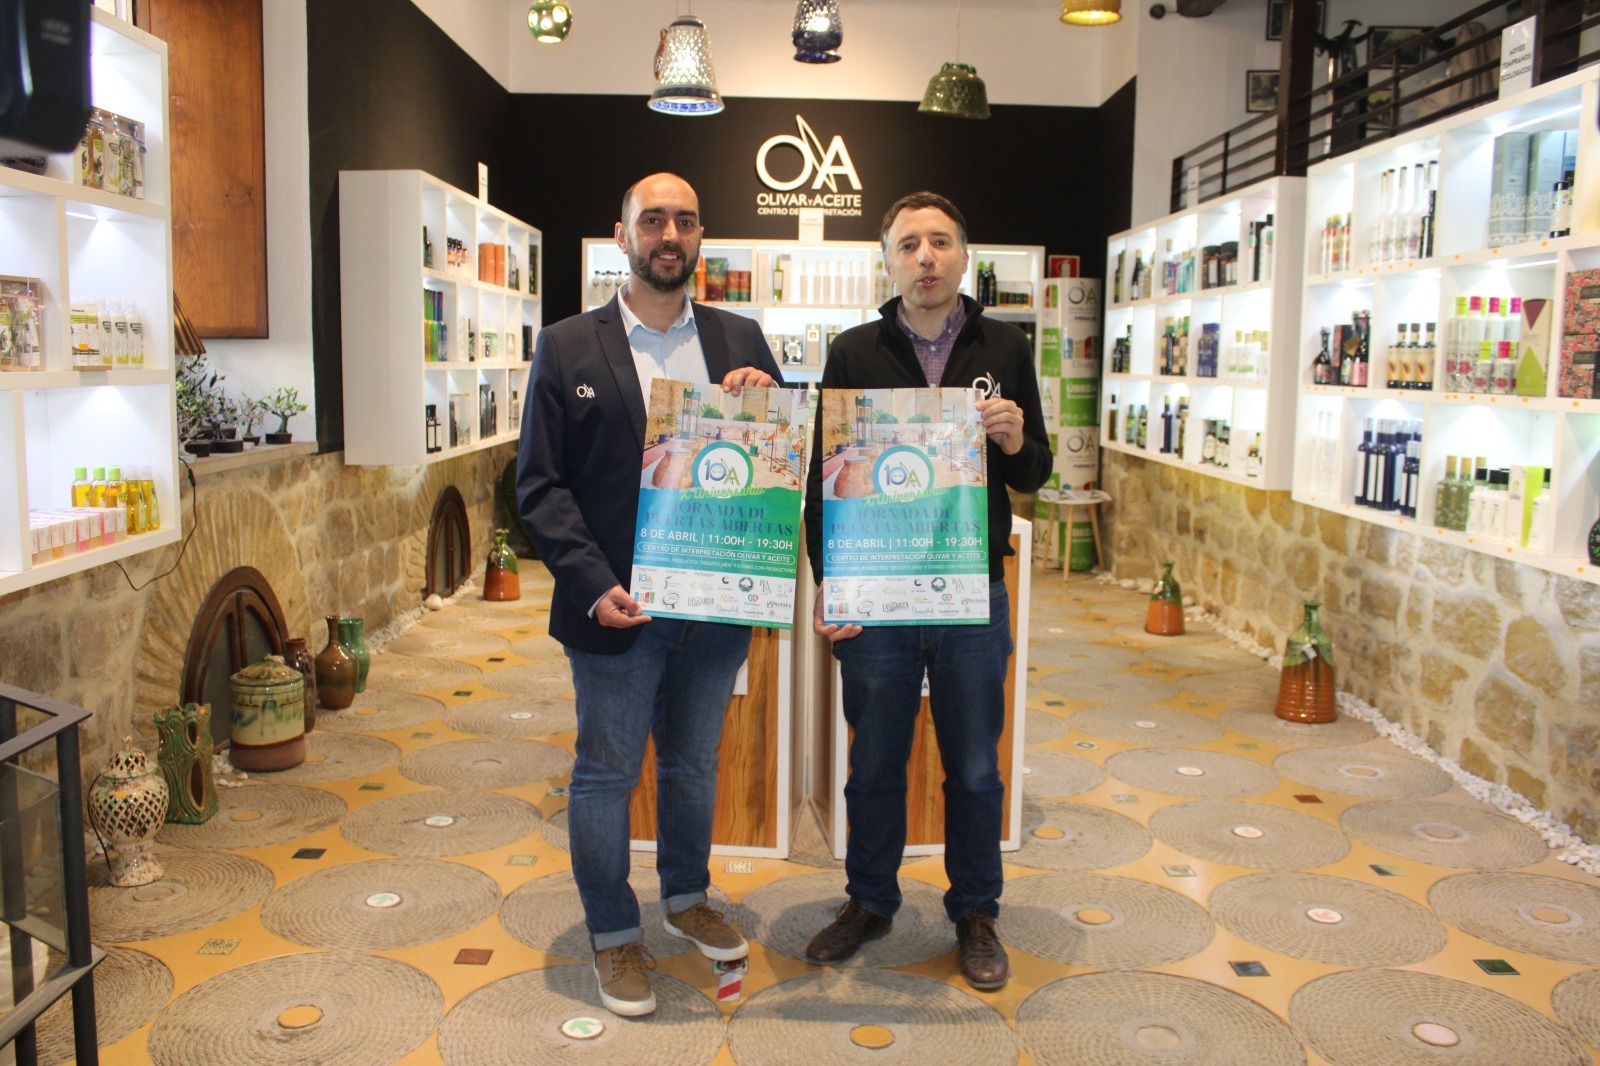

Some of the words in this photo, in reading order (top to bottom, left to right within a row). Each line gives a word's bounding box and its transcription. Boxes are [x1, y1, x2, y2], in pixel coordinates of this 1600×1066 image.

[756, 193, 808, 207] OLIVAR
[812, 194, 862, 208] ACEITE
[757, 207, 788, 216] CENTRO
[674, 500, 744, 520] JORNADA
[645, 511, 716, 530] PUERTAS
[719, 519, 793, 537] ABIERTAS
[905, 519, 981, 535] ABIERTAS
[640, 528, 648, 538] 8
[650, 529, 665, 540] DE
[667, 530, 698, 543] ABRIL
[708, 534, 746, 546] 11:00H
[756, 538, 793, 550] 19:30H
[827, 539, 835, 550] 8
[837, 539, 853, 549] DE
[855, 538, 887, 549] ABRIL
[895, 537, 934, 549] 11:00H
[944, 536, 983, 548] 19:30H
[642, 543, 670, 551] CENTRO
[670, 545, 681, 553] DE
[681, 546, 736, 558] INTERPRETACIÓN
[737, 551, 760, 560] OLIVAR
[767, 554, 791, 563] ACEITE
[831, 554, 859, 562] CENTRO
[870, 552, 926, 561] INTERPRETACIÓN
[957, 552, 981, 560] ACEITE
